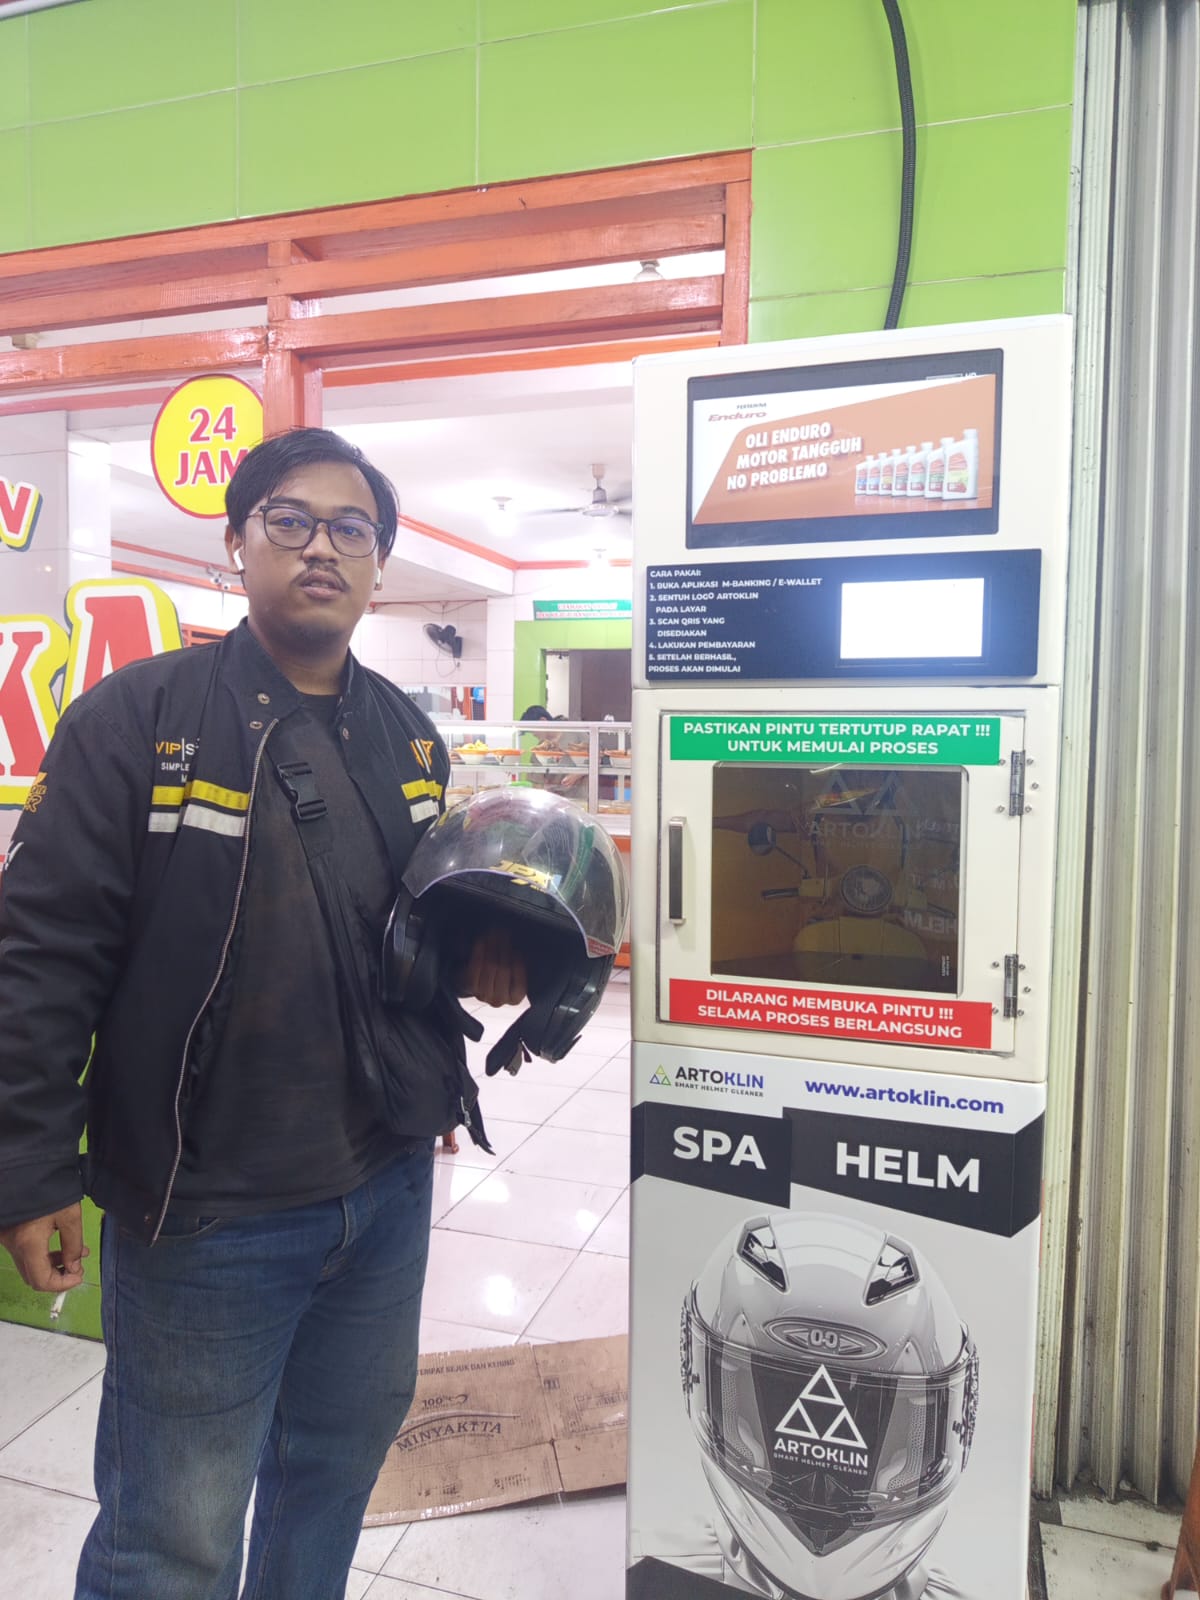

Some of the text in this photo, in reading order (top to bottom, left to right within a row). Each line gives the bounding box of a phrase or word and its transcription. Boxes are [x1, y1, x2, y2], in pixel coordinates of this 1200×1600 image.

[190, 407, 236, 442] 24
[708, 411, 767, 422] Enduro
[746, 422, 831, 448] OLI ENDURO
[736, 437, 862, 469] MOTOR TANGGUH
[175, 449, 248, 485] JAM
[726, 462, 828, 490] NO PROBLEMO
[650, 570, 672, 578] CARA
[650, 582, 656, 590] 1.
[657, 582, 680, 590] BUKA
[722, 580, 771, 588] M-BANKING
[772, 578, 777, 588] /
[778, 578, 822, 586] E-WALLET
[658, 594, 690, 602] SENTUH
[692, 592, 714, 601] LOGO
[716, 592, 758, 600] ARTOKLIN
[656, 606, 678, 614] PADA
[681, 618, 700, 626] QRIS
[683, 722, 990, 736] PASTIKAN PINTU TERTUTUP RAPAT !!!
[727, 740, 938, 754] UNTUK MEMULAI PROSES
[161, 762, 190, 772] SIMPLE
[706, 988, 954, 1020] DILARANG MEMBUKA PINTU !!!
[698, 1005, 962, 1039] SELAMA PROSES BERLANGSUNG
[675, 1066, 764, 1089] ARTOKLIN
[674, 1082, 764, 1098] SMART HELMET CLEANER
[805, 1080, 1004, 1114] www.artoklin.com
[673, 1126, 767, 1170] SPA
[836, 1141, 980, 1193] HELM
[774, 1438, 868, 1468] ARTOKLIN
[774, 1452, 868, 1476] SMART HELMET CLEANER
